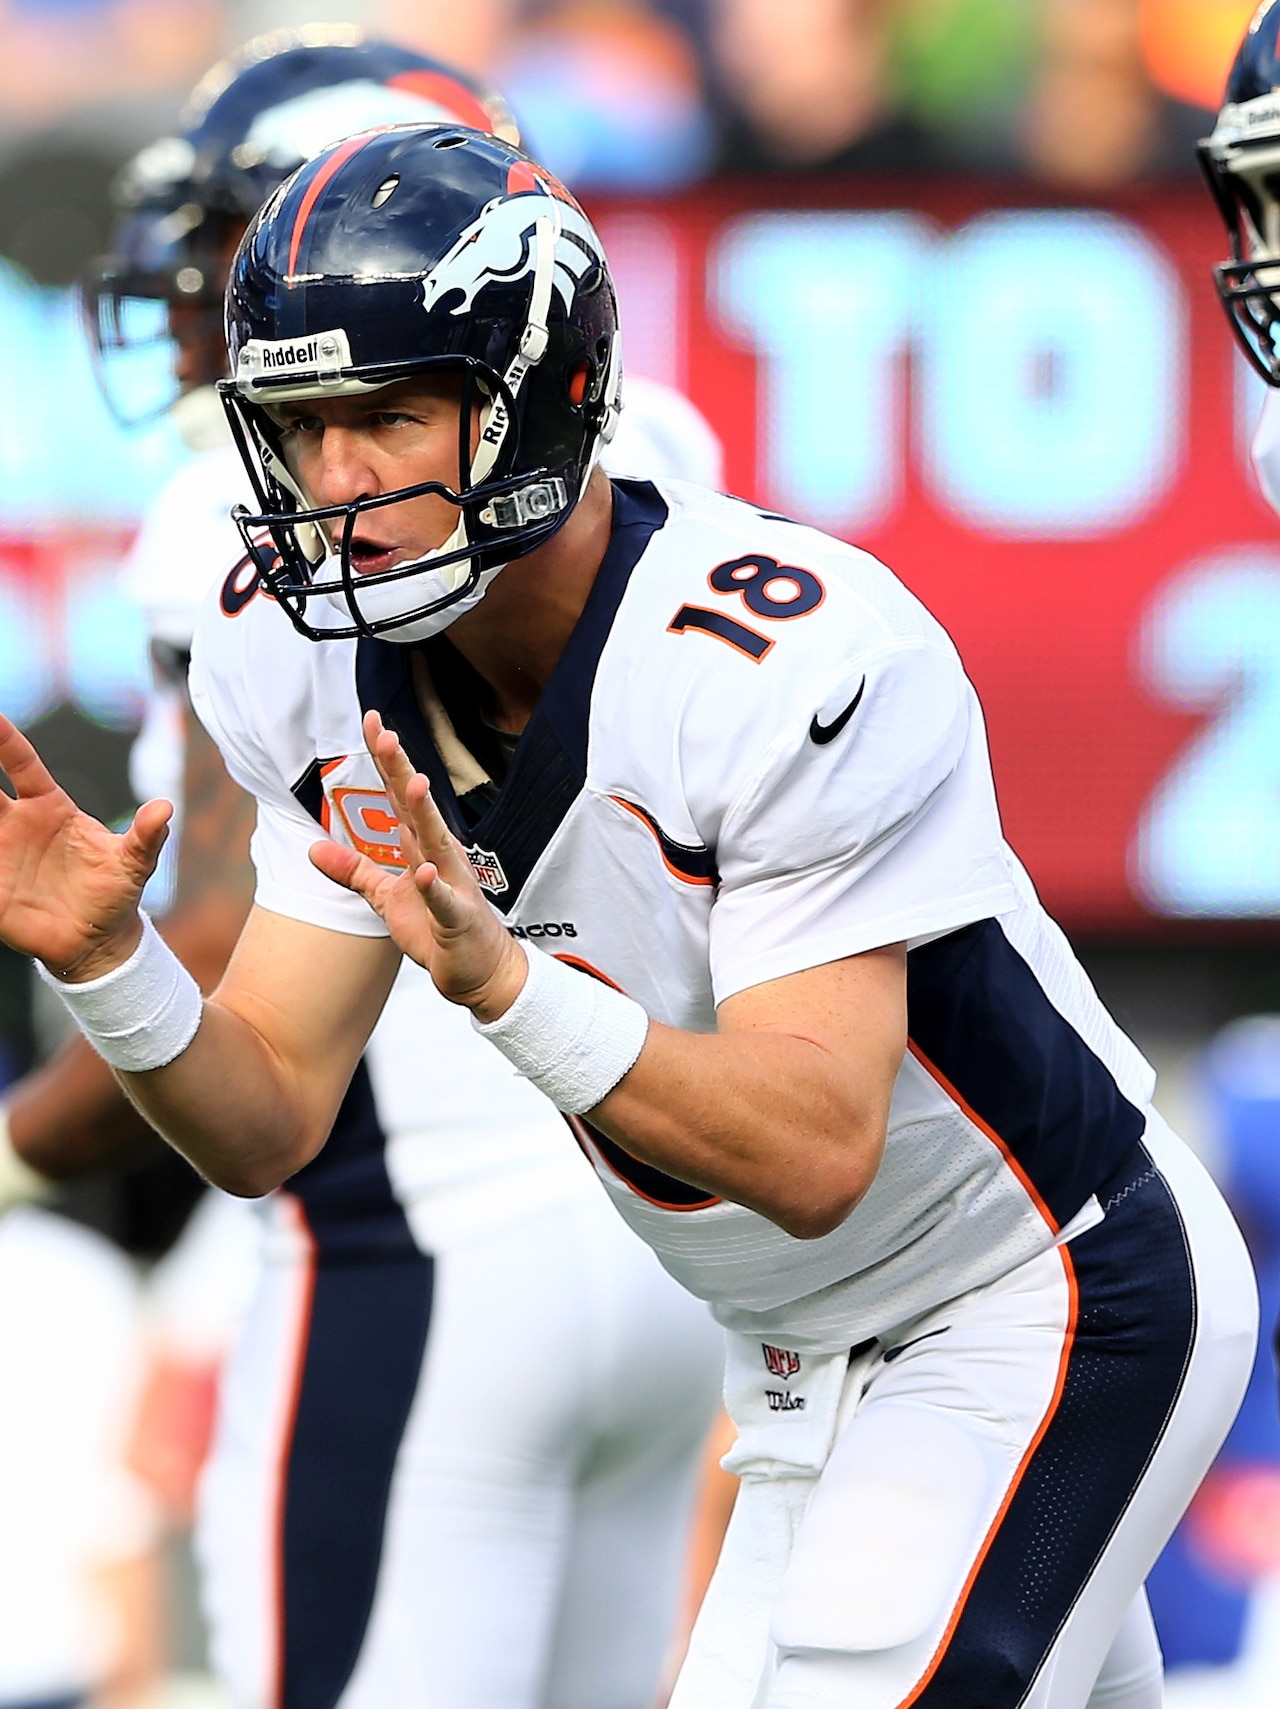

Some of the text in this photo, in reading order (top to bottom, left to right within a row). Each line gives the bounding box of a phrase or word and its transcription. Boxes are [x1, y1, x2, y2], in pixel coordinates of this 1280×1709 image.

[263, 341, 318, 368] Riddell
[666, 553, 826, 665] 18
[507, 922, 578, 939] NCOS
